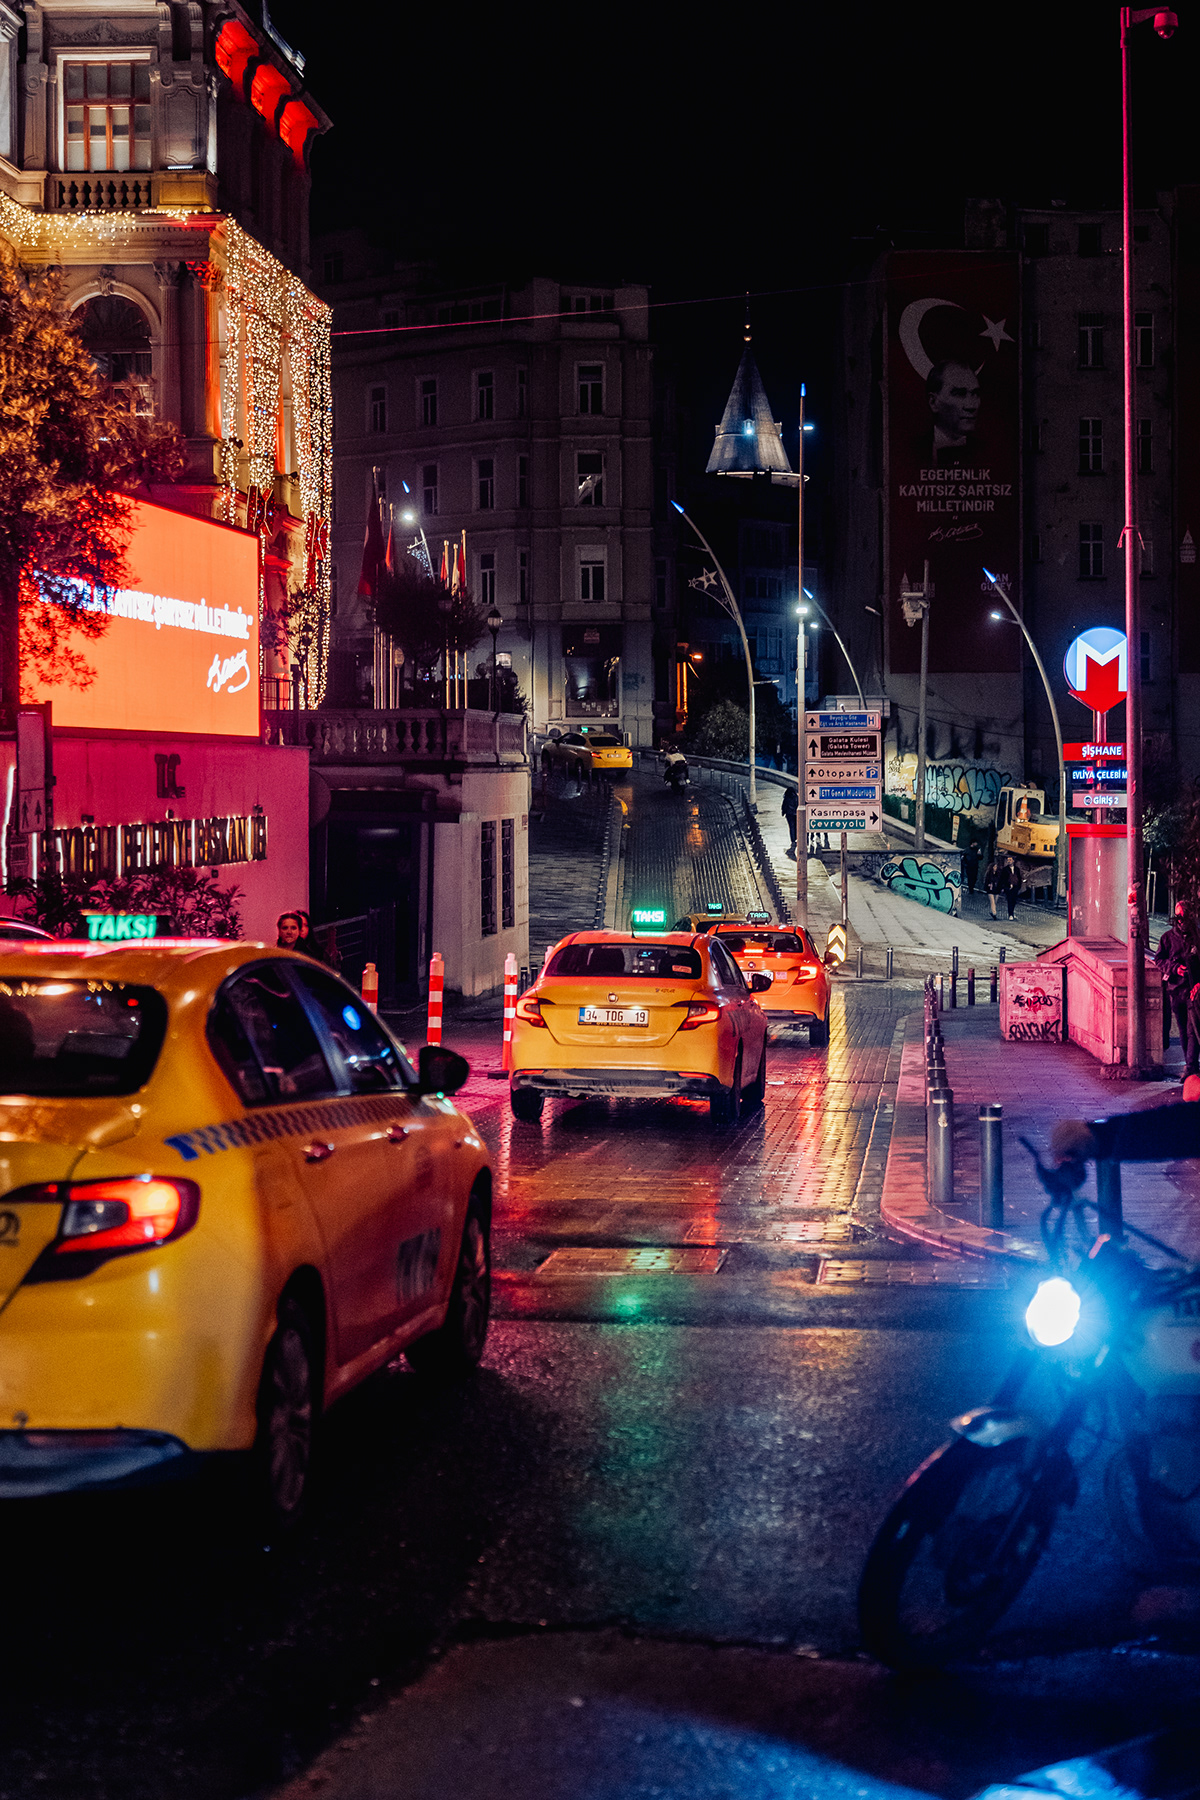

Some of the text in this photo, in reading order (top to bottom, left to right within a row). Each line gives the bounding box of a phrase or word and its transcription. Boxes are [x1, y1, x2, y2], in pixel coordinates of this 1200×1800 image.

[919, 468, 991, 481] EGEMENLİK
[899, 483, 1012, 498] KAYITSIZ ŞARTSIZ
[916, 499, 995, 512] MİLLETİNDİR
[1081, 744, 1122, 758] ŞİŞHANE
[818, 768, 864, 779] Otopark
[1072, 769, 1095, 779] EVLİYA
[1096, 769, 1121, 781] ÇELEBİ
[831, 789, 846, 797] Genel
[1093, 795, 1113, 806] GİRİŞ
[811, 808, 866, 818] Kasımpaşa
[810, 820, 865, 829] Çevreyolu
[586, 1010, 597, 1021] 34
[635, 1012, 646, 1022] 19
